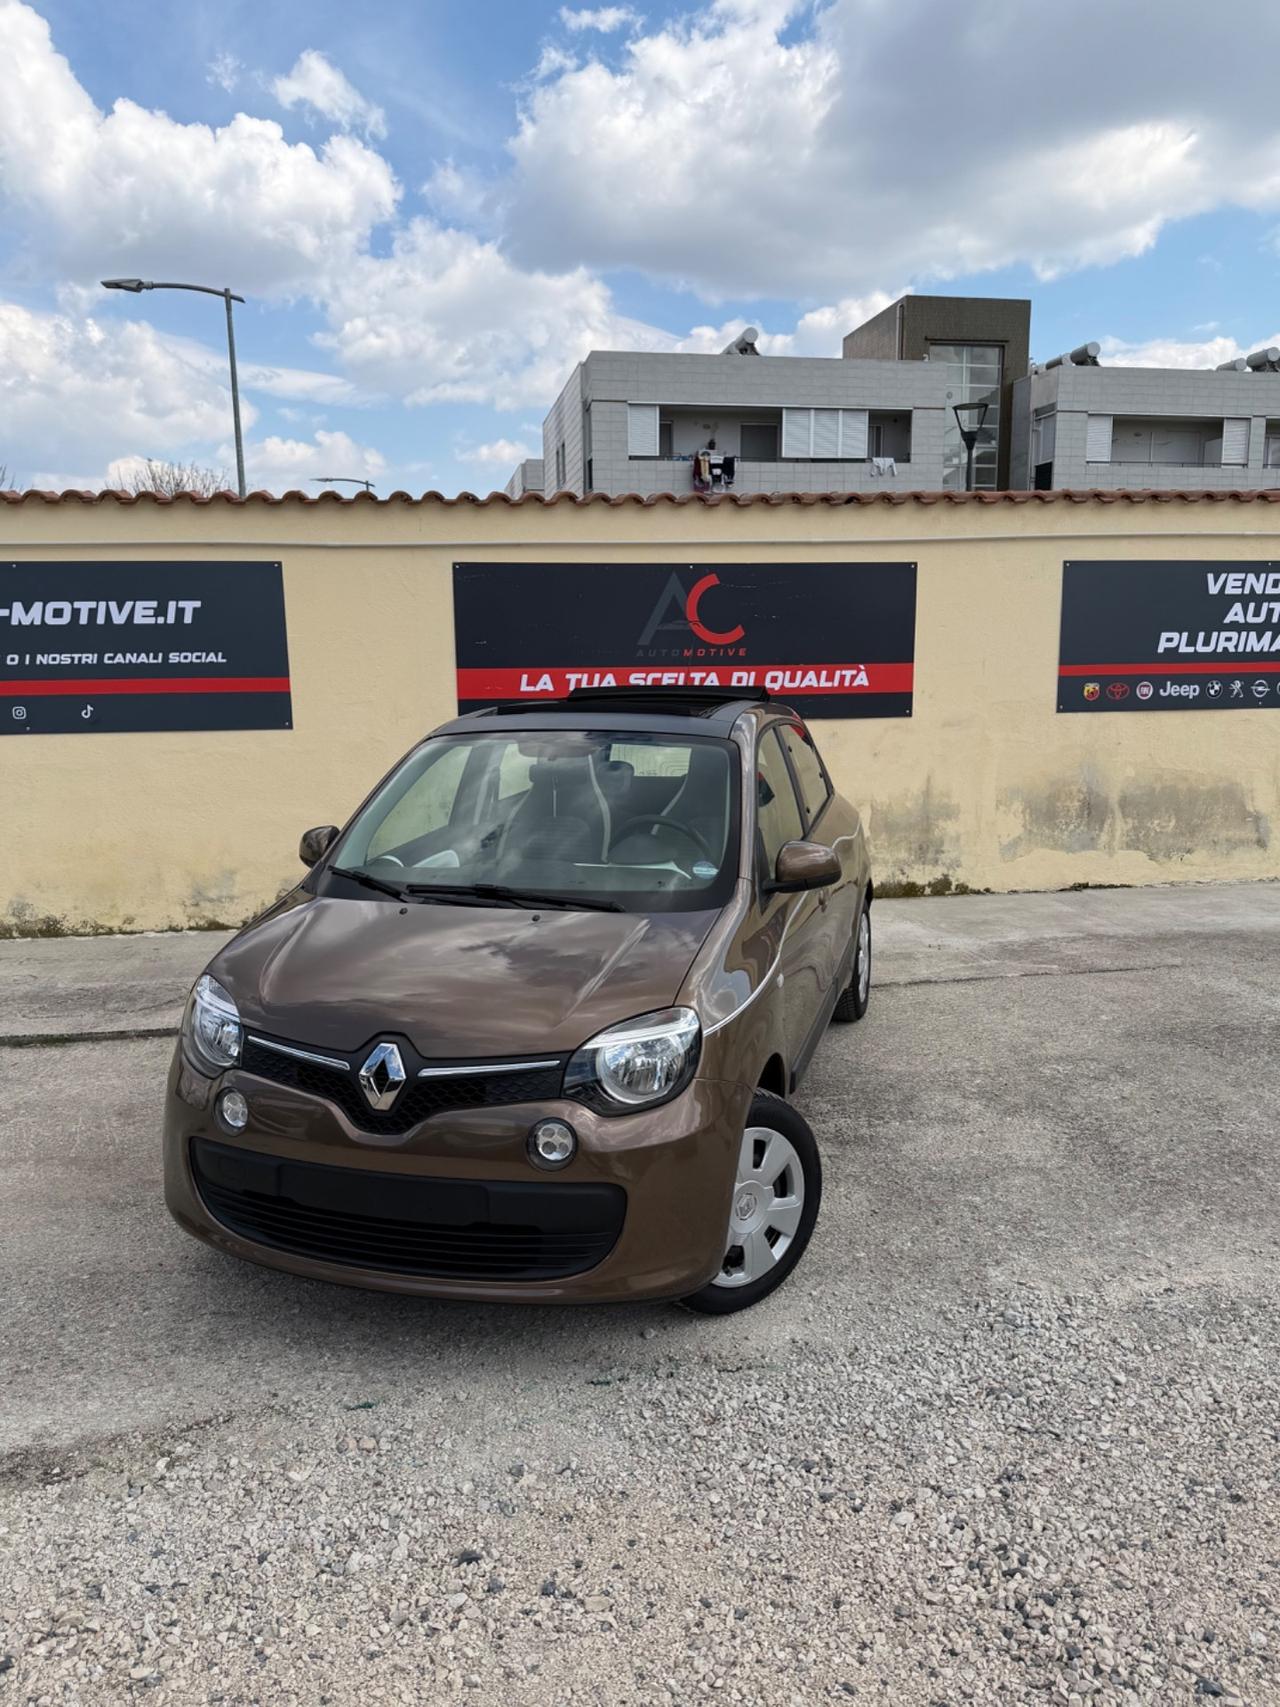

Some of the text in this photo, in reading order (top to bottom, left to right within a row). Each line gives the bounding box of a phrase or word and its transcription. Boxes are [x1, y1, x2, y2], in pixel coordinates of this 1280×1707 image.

[25, 653, 30, 665] I
[35, 653, 98, 665] NOSTRI
[103, 652, 163, 664] CANALI
[168, 651, 227, 664] SOCIAL
[636, 647, 747, 657] AUTOMOTIVE
[519, 673, 555, 692] LA
[565, 672, 617, 691] TUA
[730, 671, 756, 687] DI
[764, 664, 870, 691] QUALITÀ
[1159, 680, 1200, 699] Jeep
